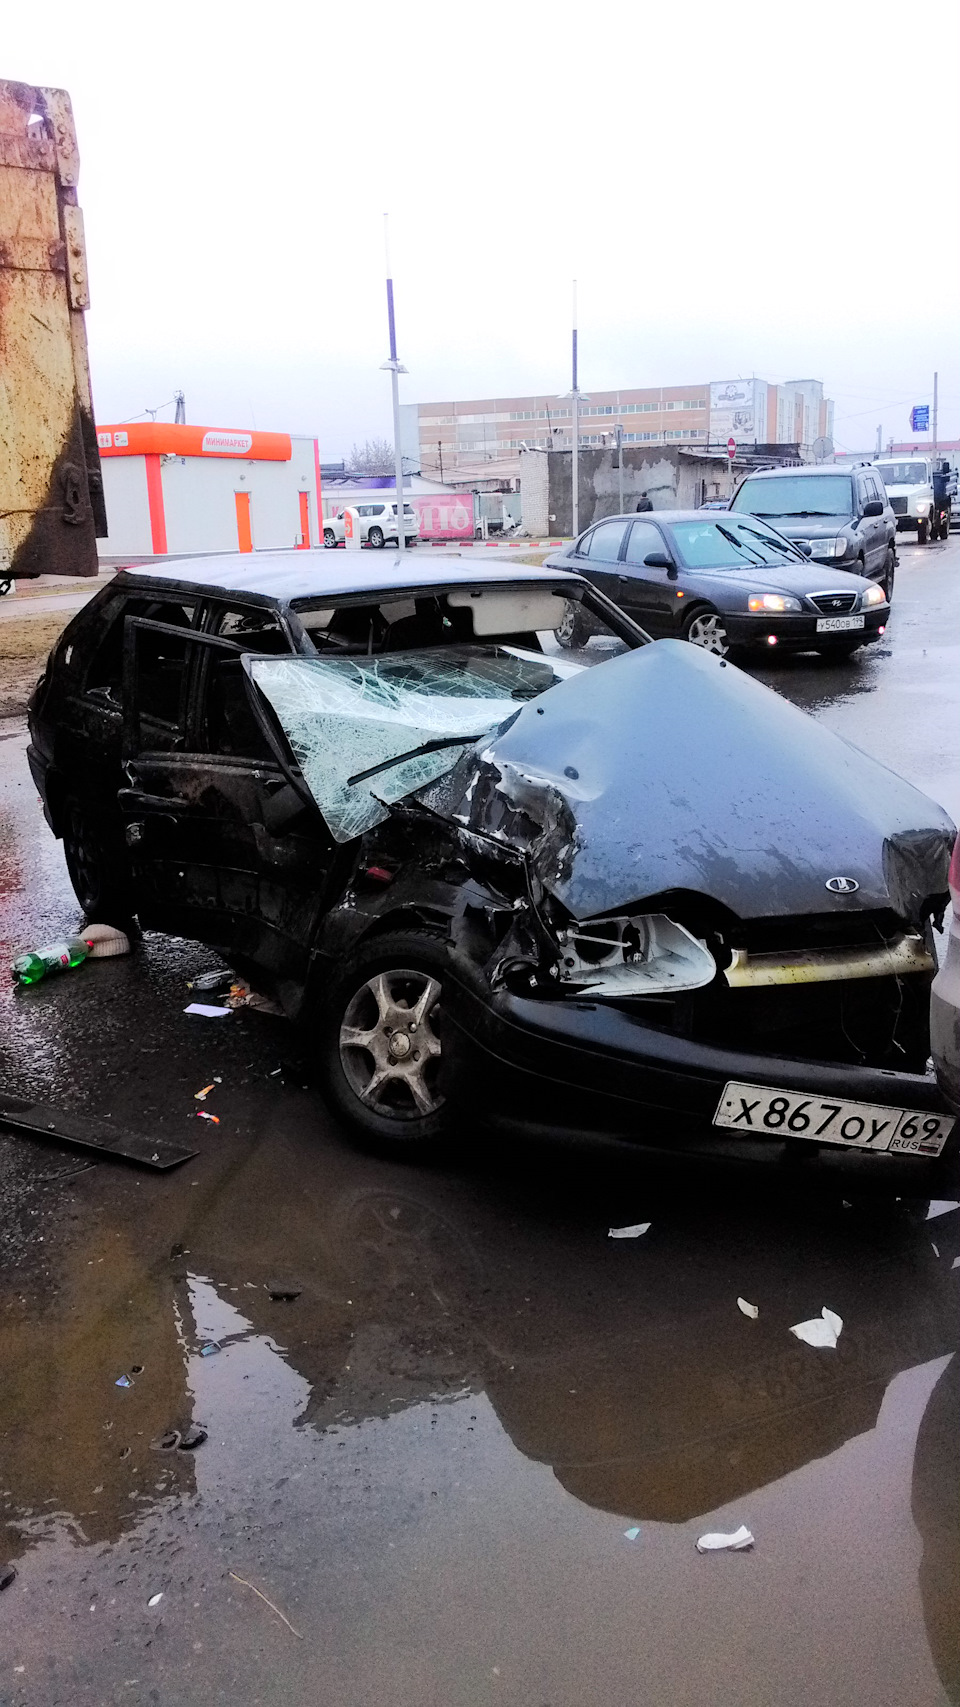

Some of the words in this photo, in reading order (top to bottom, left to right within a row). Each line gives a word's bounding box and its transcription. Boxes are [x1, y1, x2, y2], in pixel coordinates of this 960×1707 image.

[205, 437, 249, 448] МИНИМАРКЕТ
[732, 1097, 890, 1143] Х867ОУ
[900, 1116, 940, 1141] 69
[891, 1138, 919, 1151] RUS
